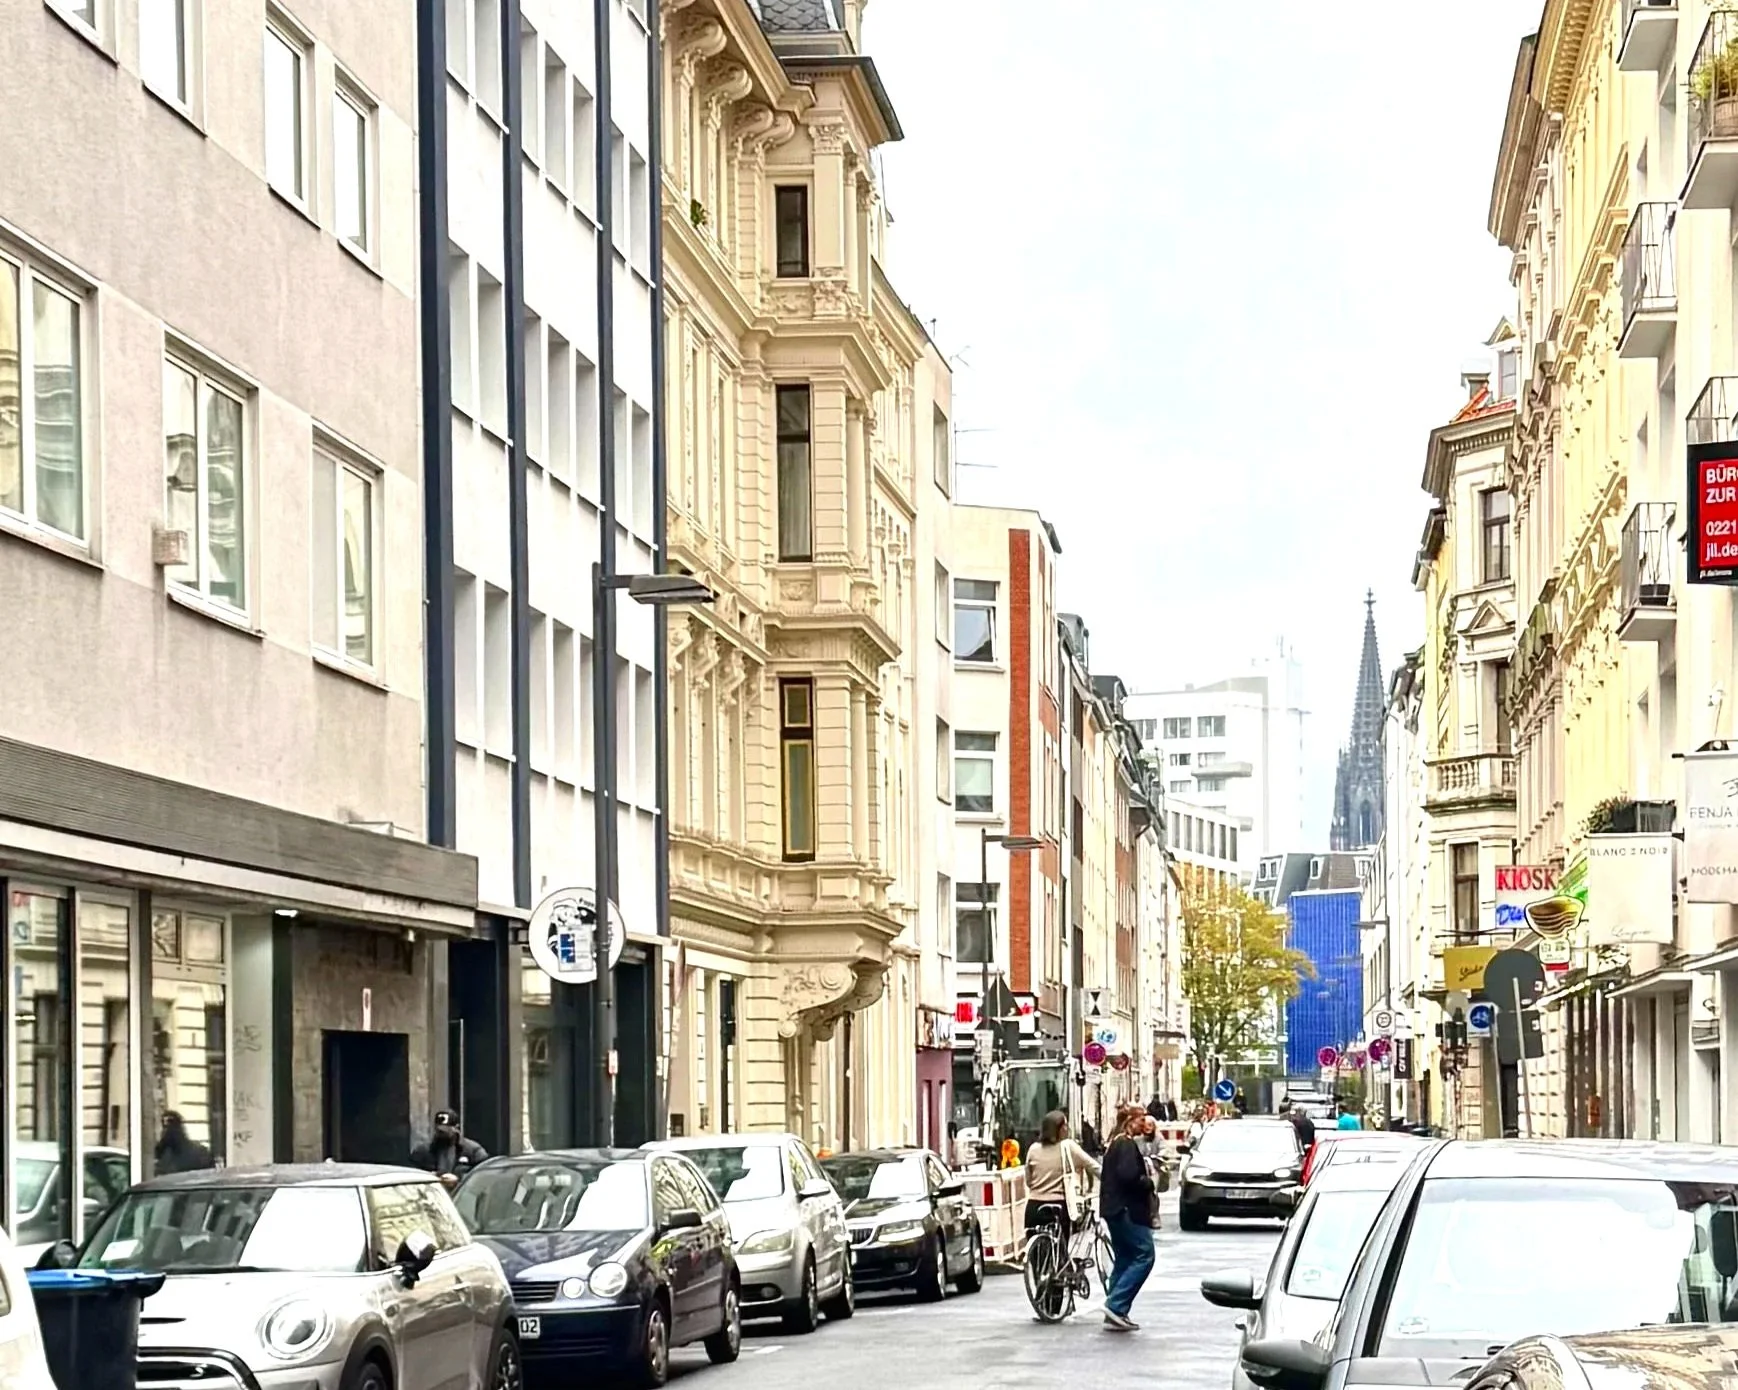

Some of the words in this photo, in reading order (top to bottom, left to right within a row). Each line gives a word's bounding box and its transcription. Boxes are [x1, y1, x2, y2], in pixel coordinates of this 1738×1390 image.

[1706, 464, 1738, 484] BÜR
[1706, 486, 1736, 504] ZUR
[1706, 519, 1737, 536] 0221
[1705, 541, 1738, 561] jll.de
[1590, 847, 1626, 856] BLANC
[1496, 868, 1557, 890] KIOSK
[519, 1319, 538, 1334] 02
